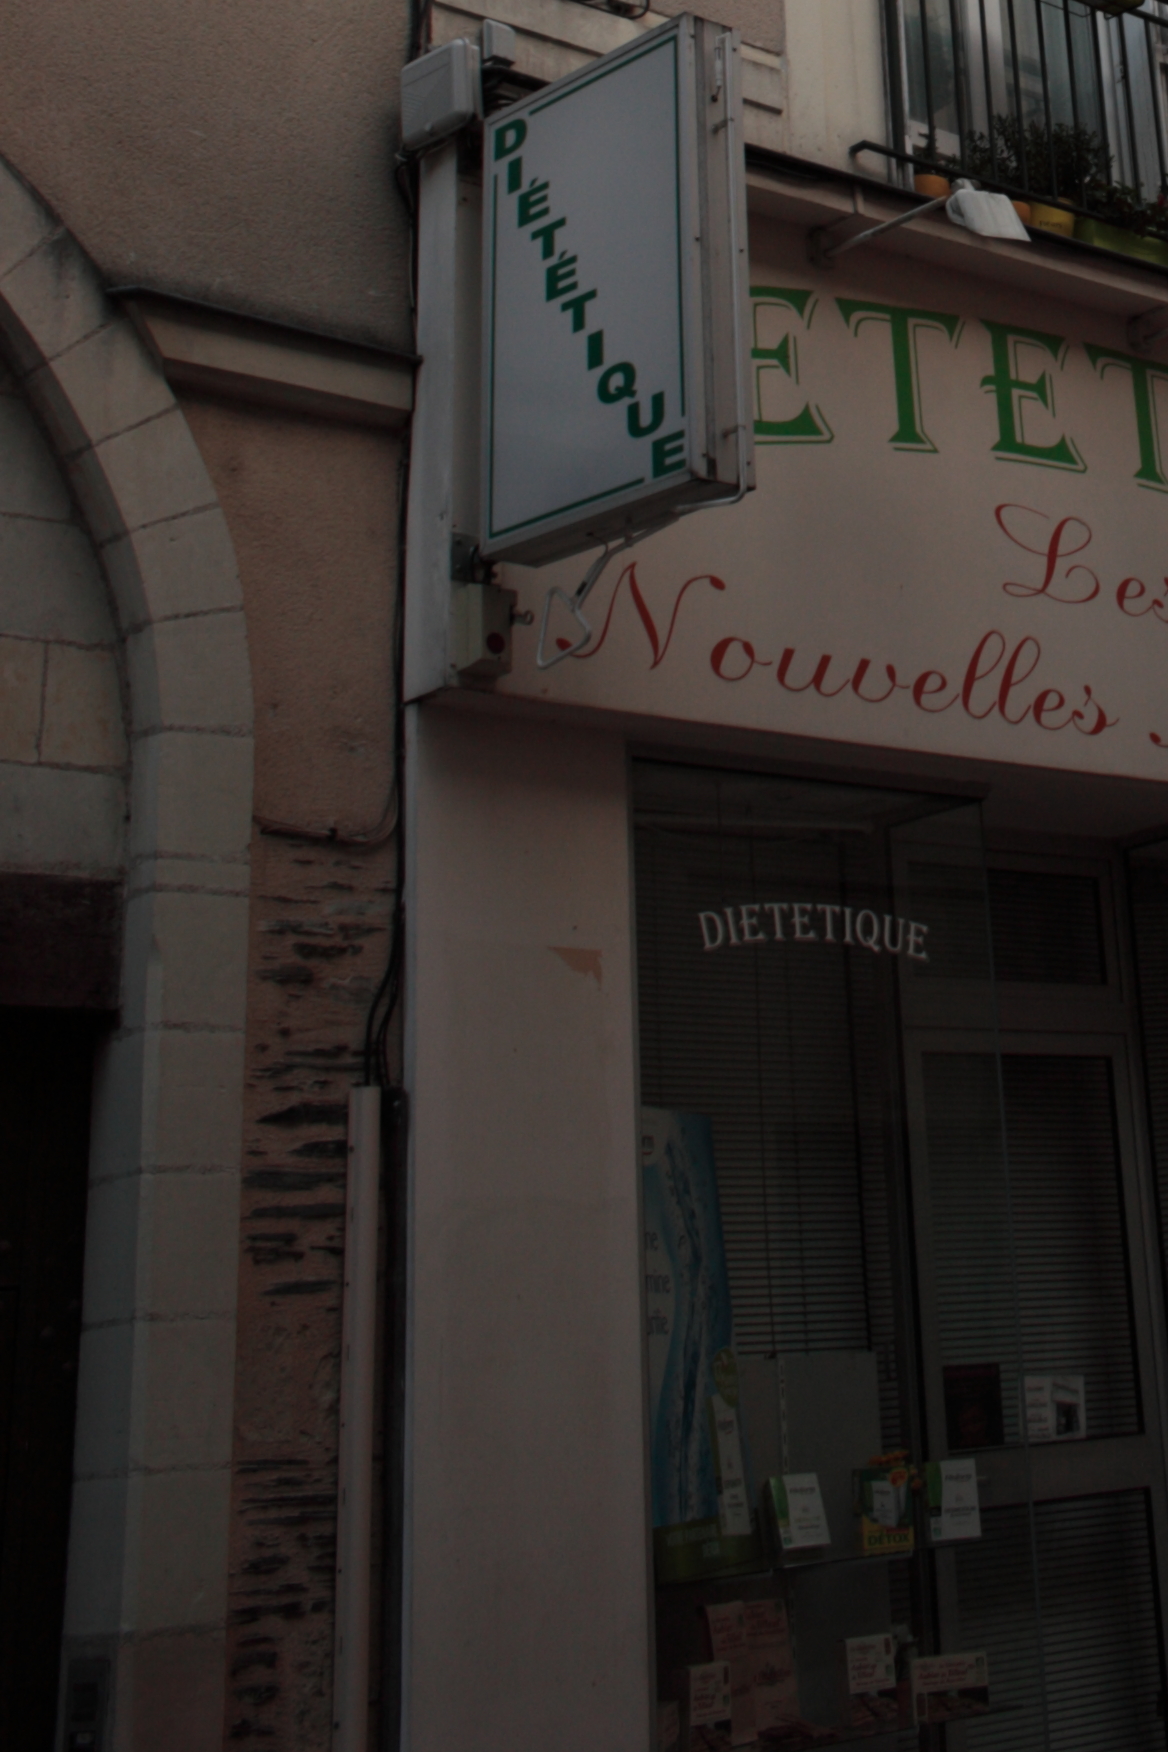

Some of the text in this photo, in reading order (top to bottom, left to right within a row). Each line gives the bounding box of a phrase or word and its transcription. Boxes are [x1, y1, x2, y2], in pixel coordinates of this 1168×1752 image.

[494, 119, 687, 479] DIÉTÉTIQUE
[555, 561, 1121, 738] Nouvelles
[698, 901, 931, 963] DIETETIQUE
